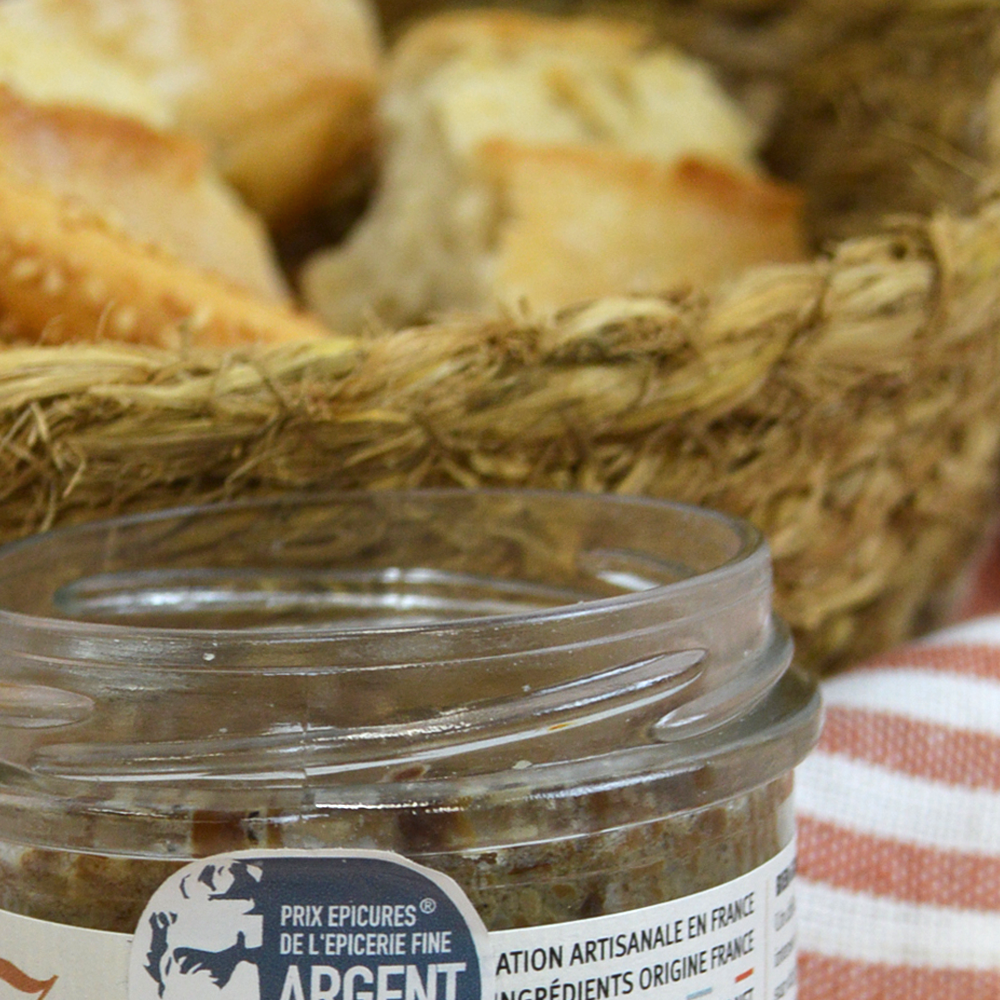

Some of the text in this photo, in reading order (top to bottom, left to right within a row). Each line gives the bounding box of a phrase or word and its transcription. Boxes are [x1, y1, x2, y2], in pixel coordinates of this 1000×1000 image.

[281, 905, 323, 927] PRIX
[569, 919, 684, 966] ARTISANALE
[688, 915, 707, 940] EN
[711, 892, 755, 932] FRANCE
[279, 931, 452, 956] DE L'EPICERIE FINE
[639, 951, 707, 990] ORIGINE
[711, 929, 755, 969] FRANCE
